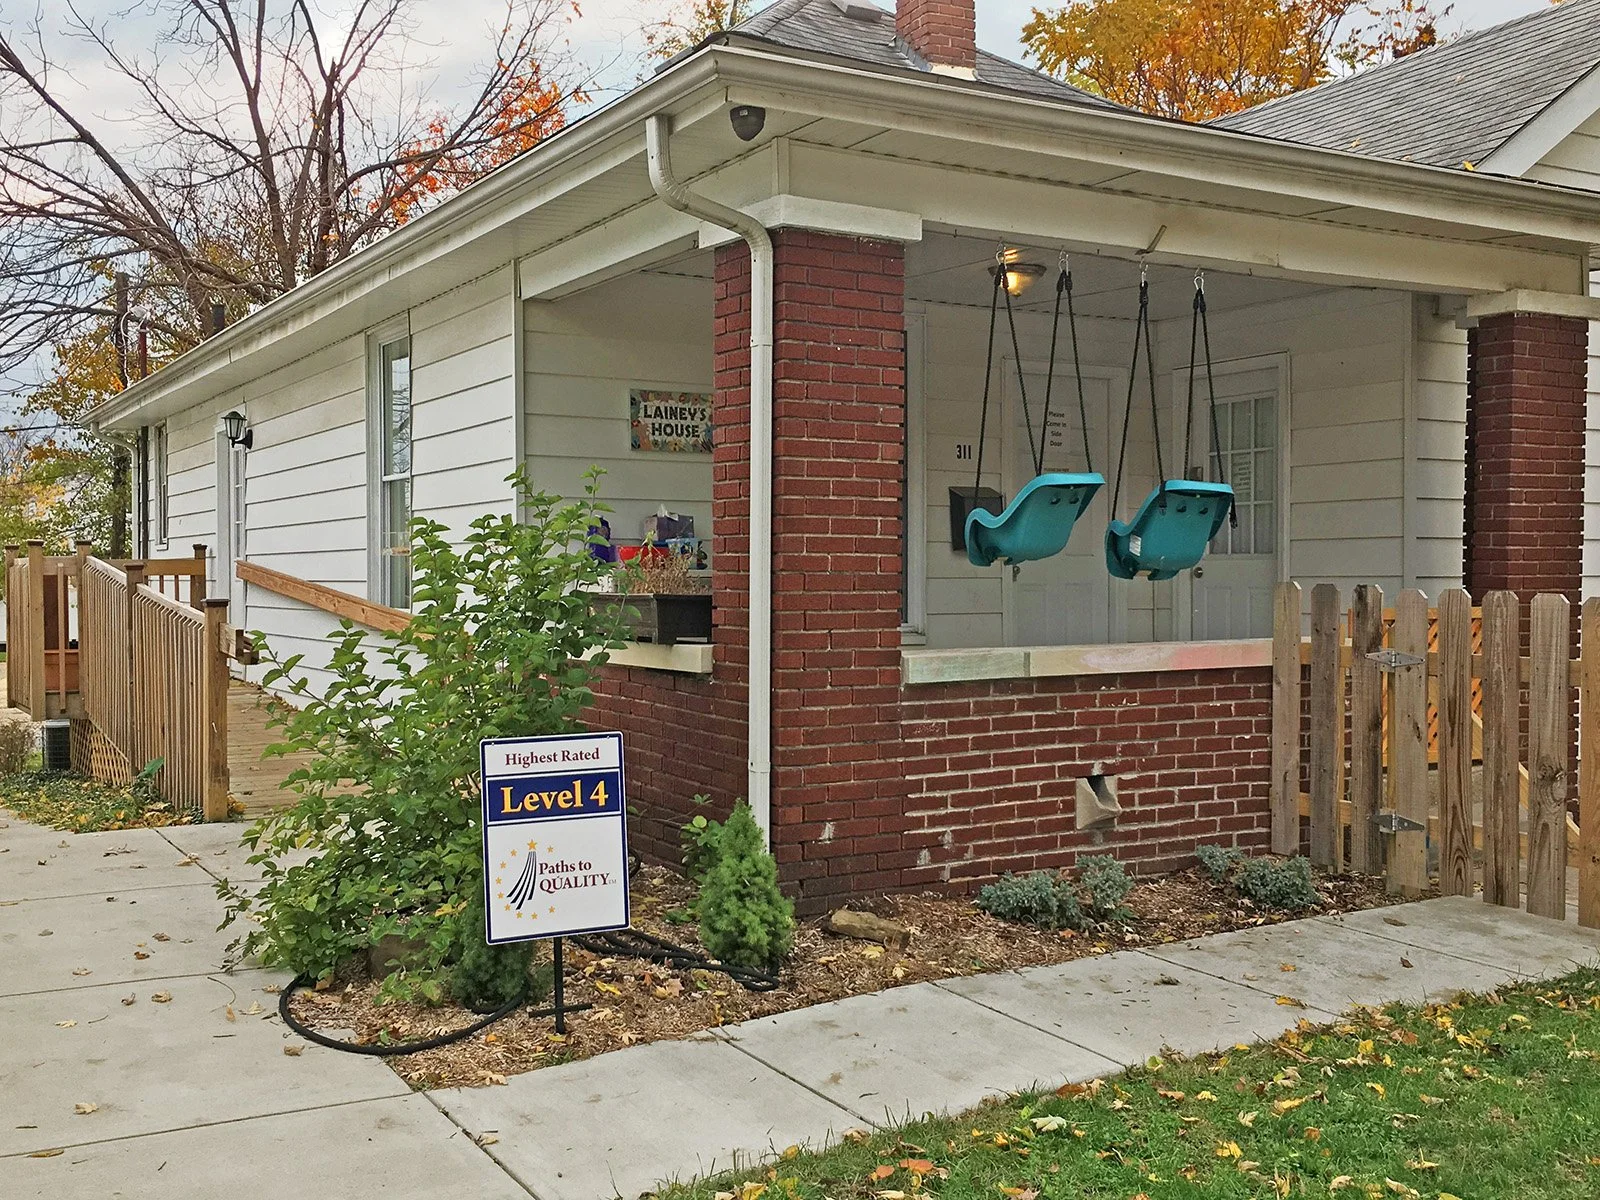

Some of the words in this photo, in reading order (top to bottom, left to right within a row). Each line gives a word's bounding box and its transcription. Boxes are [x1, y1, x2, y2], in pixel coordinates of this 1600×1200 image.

[643, 404, 707, 421] LAINEY'S
[651, 422, 700, 438] HOUSE
[956, 444, 972, 460] 311
[505, 751, 558, 768] Highest
[561, 747, 600, 762] Rated
[500, 779, 584, 814] Level
[589, 780, 609, 807] 4
[539, 860, 576, 876] Paths
[578, 860, 592, 872] to
[539, 872, 610, 894] QUALITY
